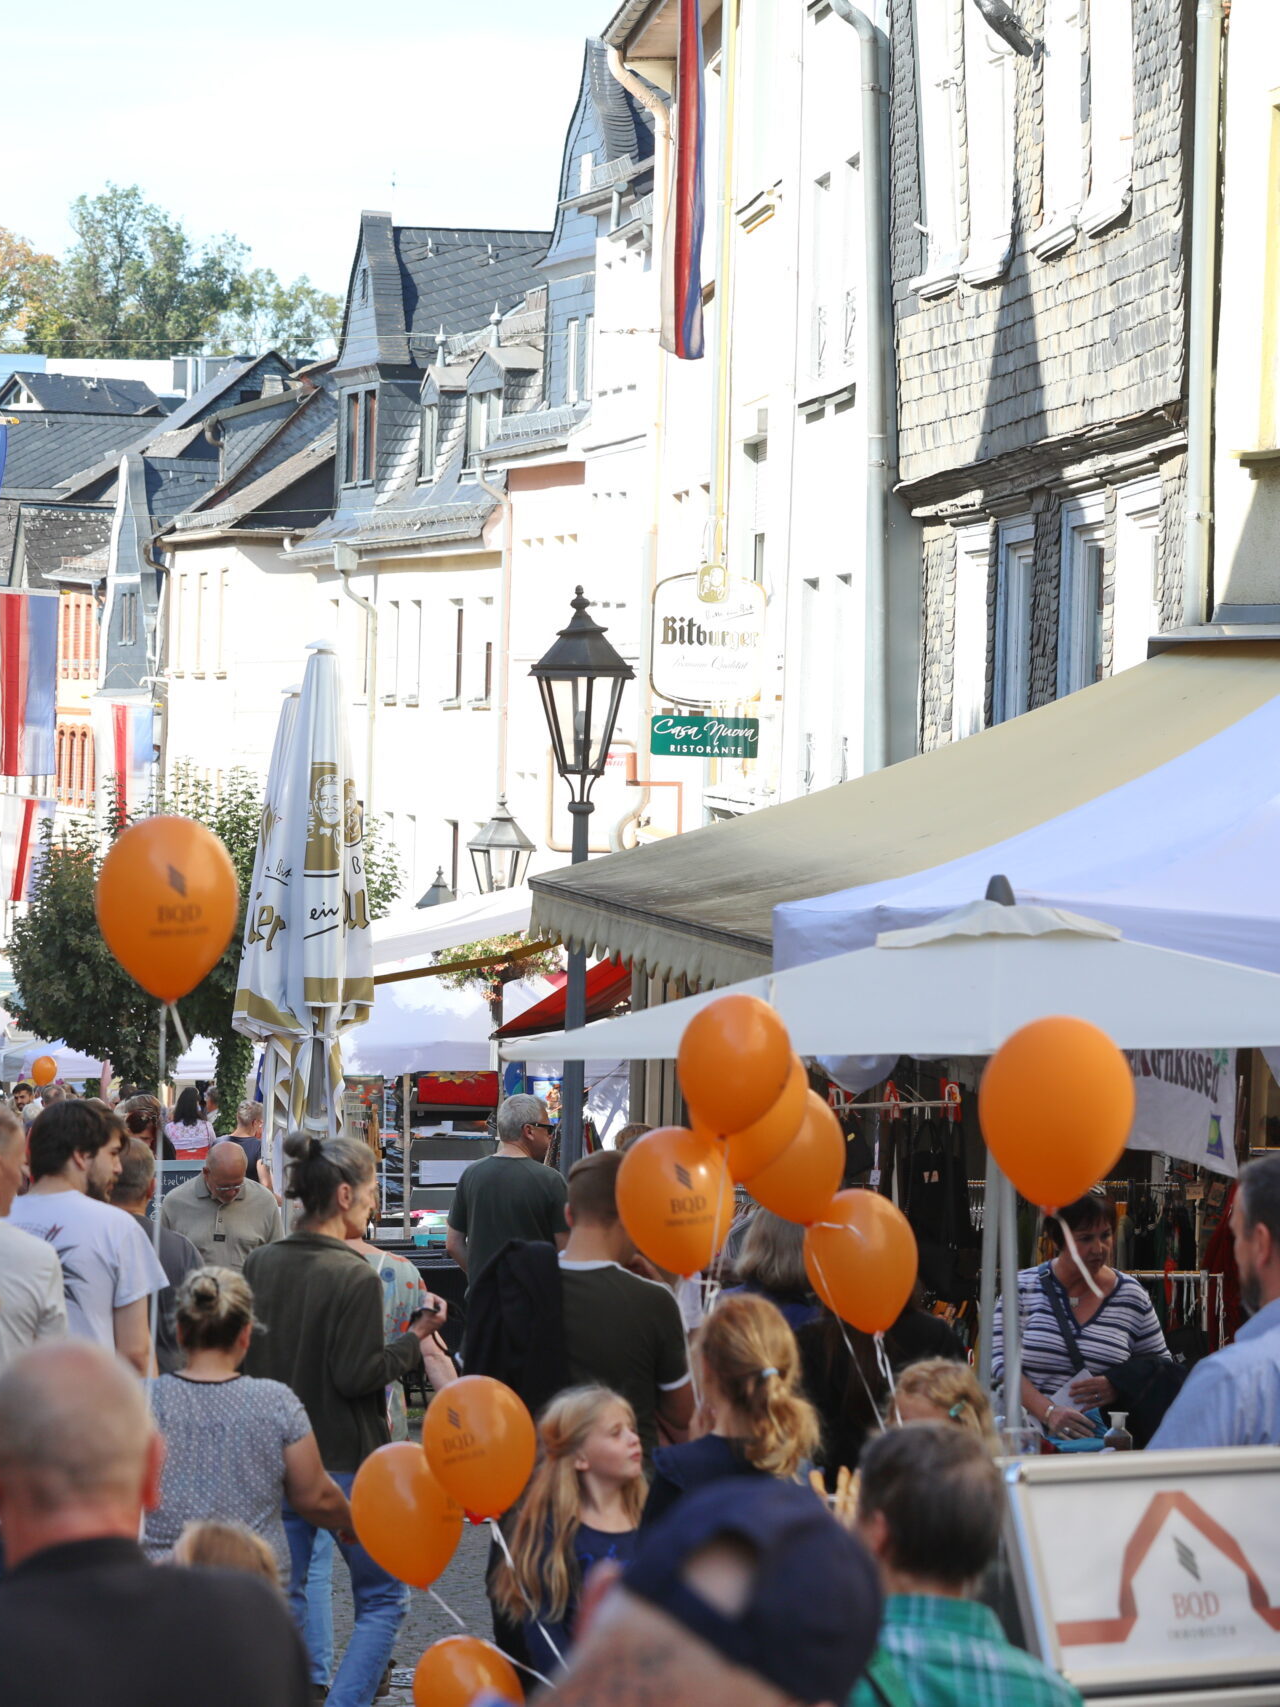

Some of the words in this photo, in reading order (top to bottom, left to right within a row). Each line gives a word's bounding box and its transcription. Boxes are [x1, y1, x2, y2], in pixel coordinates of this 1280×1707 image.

[660, 615, 759, 650] Bitburger
[654, 718, 702, 740] Casa
[703, 720, 759, 745] Nuova
[670, 744, 743, 755] RISTORANTE
[669, 1195, 707, 1214] BQD
[442, 1433, 475, 1452] BQD
[1172, 1590, 1220, 1621] BQD
